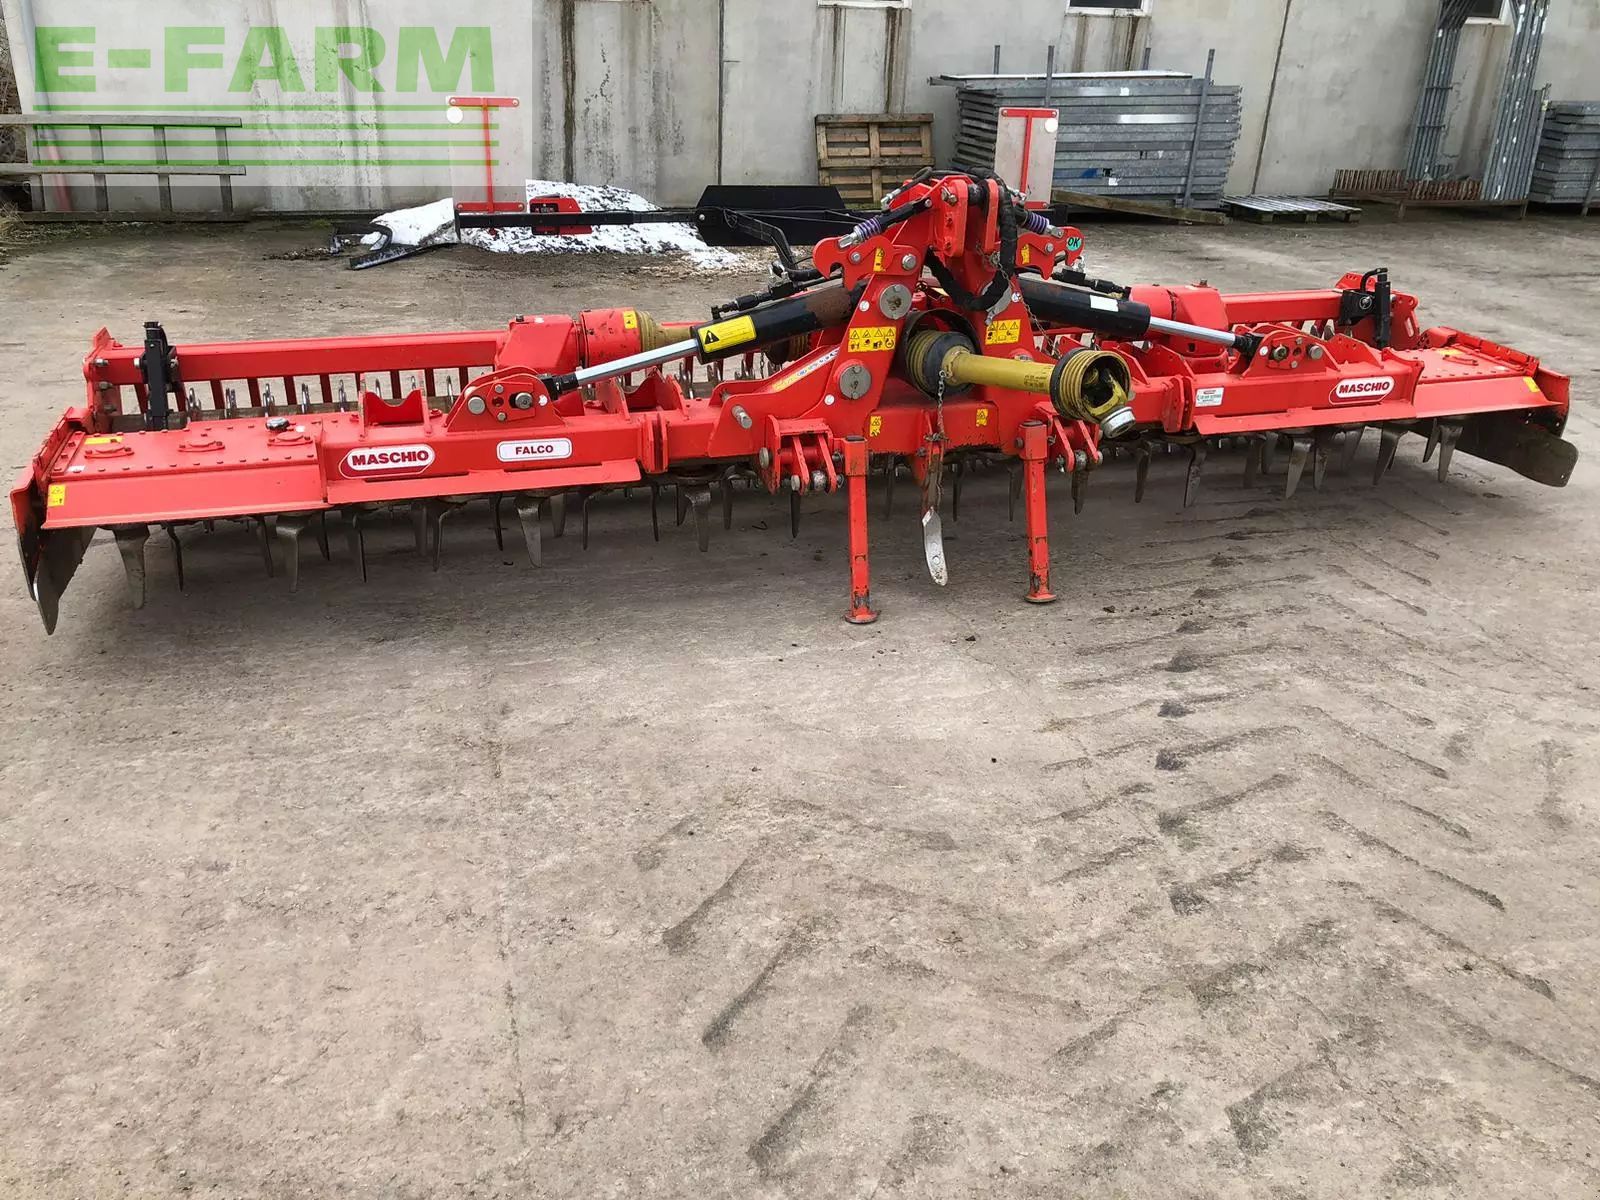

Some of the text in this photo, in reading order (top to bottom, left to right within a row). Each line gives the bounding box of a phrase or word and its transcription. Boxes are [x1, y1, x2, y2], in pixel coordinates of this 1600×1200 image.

[1067, 236, 1081, 248] OK
[1338, 381, 1390, 394] MASCHIO
[515, 444, 554, 455] FALCO
[351, 450, 429, 466] MASCHIO
